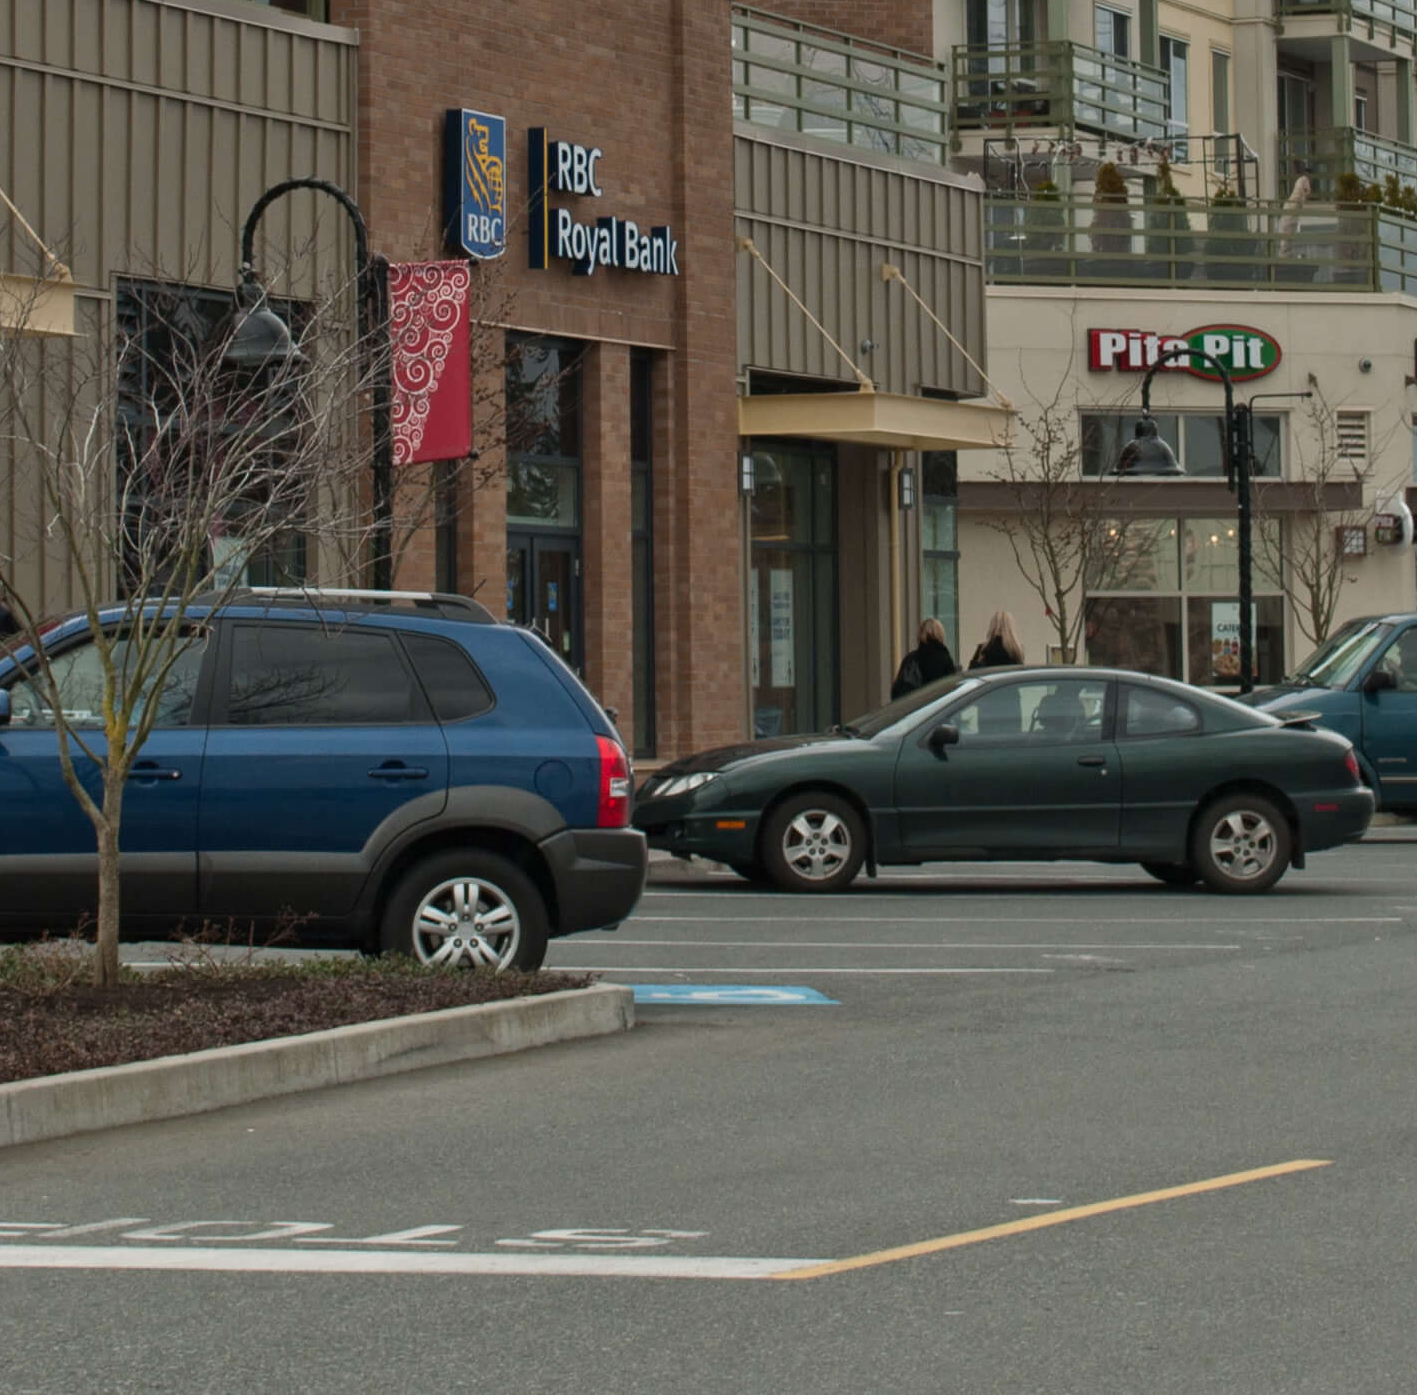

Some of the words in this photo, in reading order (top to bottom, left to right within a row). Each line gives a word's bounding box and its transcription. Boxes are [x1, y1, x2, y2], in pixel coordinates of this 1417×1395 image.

[558, 141, 602, 197] RBC
[468, 213, 502, 246] RBC
[558, 208, 618, 276] Royal
[624, 220, 679, 276] Bank
[1099, 332, 1190, 367] Pita
[1203, 334, 1265, 368] Pit
